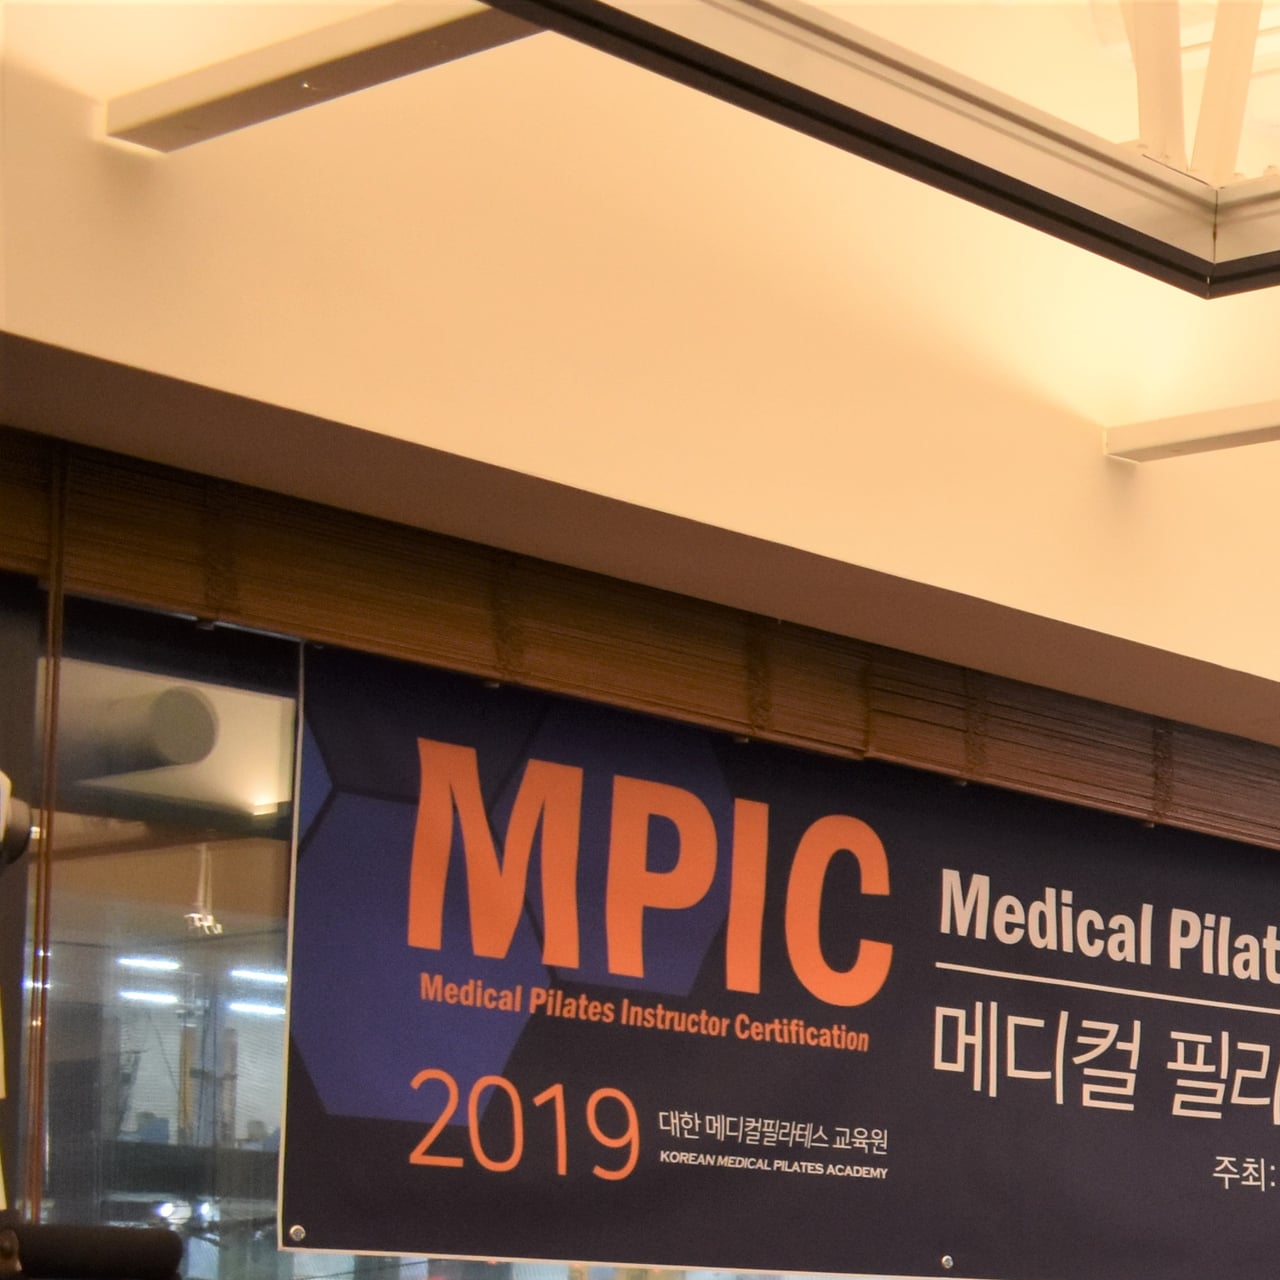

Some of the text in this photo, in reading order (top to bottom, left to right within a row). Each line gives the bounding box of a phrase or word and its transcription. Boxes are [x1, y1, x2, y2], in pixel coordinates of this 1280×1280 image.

[407, 737, 893, 1007] MPIC
[939, 868, 1153, 966] Medical
[420, 972, 869, 1052] Medical Pilates Instructor Certification
[934, 1001, 1141, 1112] 메디컬
[409, 1068, 640, 1181] 2019
[659, 1110, 888, 1155] 대한 메디컬필라테스 교육원
[660, 1151, 888, 1179] KOREAN MEDICAL PILATES ACADEMY
[1213, 1156, 1276, 1191] 주최:
